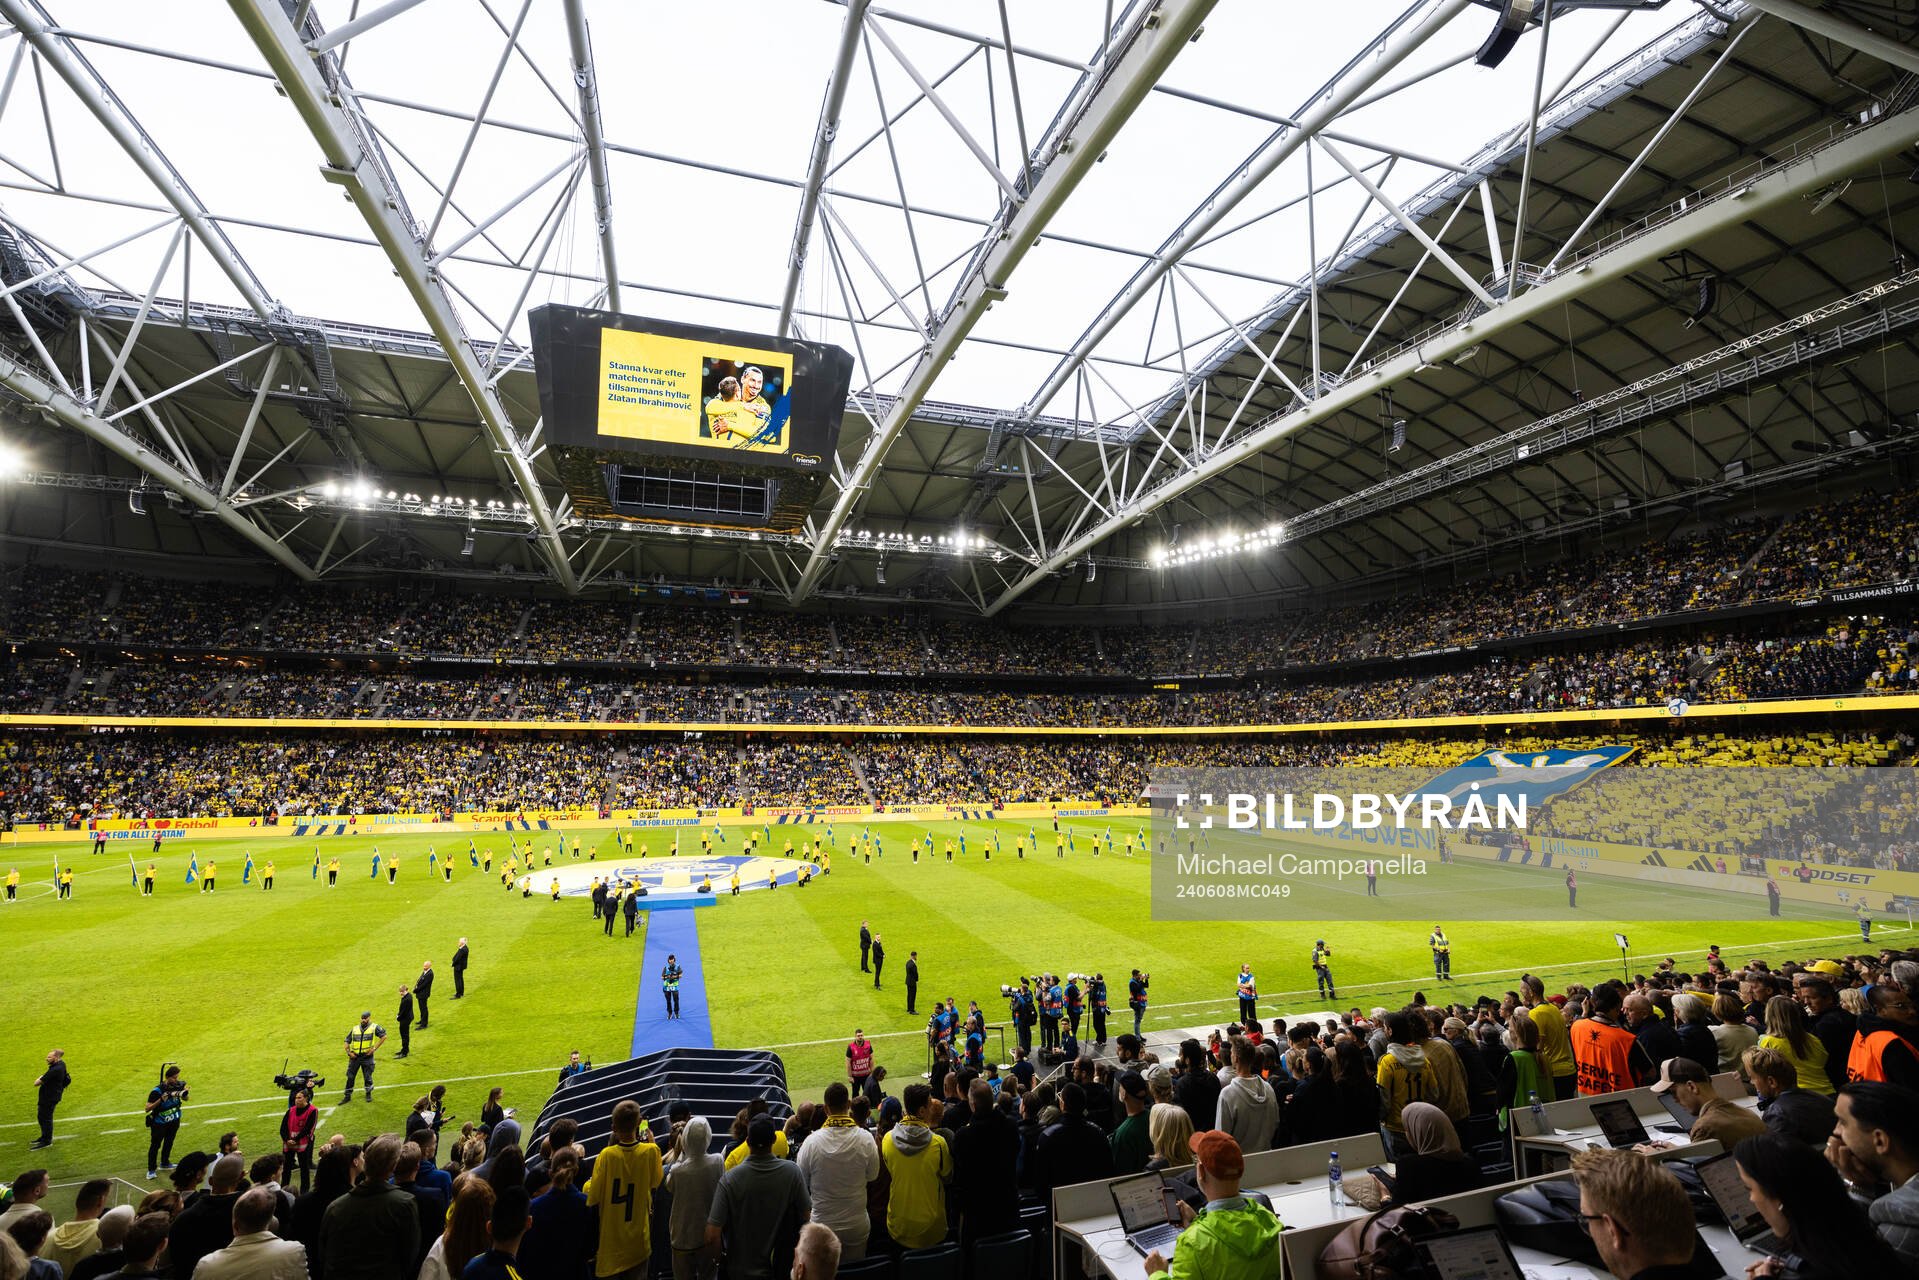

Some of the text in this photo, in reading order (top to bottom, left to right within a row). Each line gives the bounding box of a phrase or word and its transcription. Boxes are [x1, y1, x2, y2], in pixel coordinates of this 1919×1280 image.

[609, 361, 686, 378] Stanna kvar efter
[608, 373, 648, 384] matchen
[650, 377, 665, 386] när
[608, 383, 690, 400] tillsammans hyllar
[608, 393, 637, 404] Zlatan
[1832, 587, 1893, 602] TILLSAMMANS
[1895, 584, 1913, 594] MOT
[632, 819, 646, 827] TACK
[89, 831, 110, 839] TAK
[131, 830, 150, 839] ALLT
[151, 830, 186, 839] ZATAN!
[1578, 1061, 1621, 1086] SERVICE
[611, 1178, 635, 1222] 4
